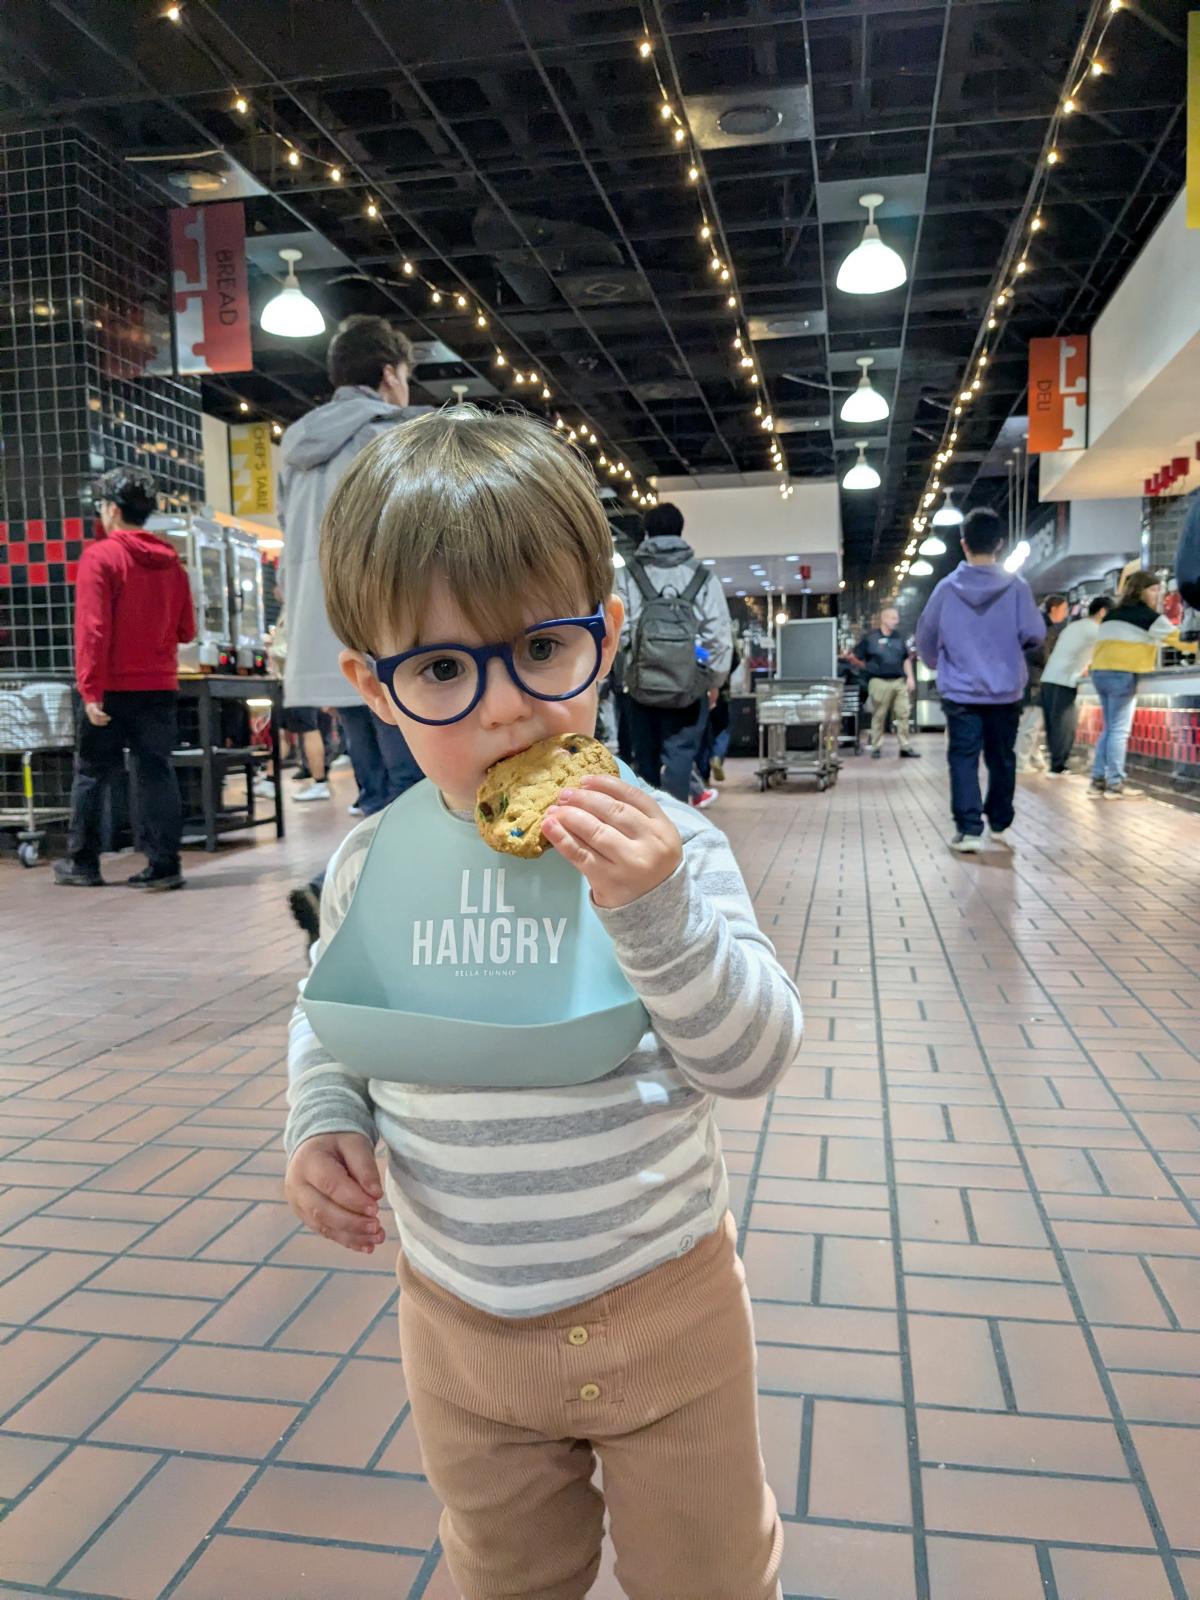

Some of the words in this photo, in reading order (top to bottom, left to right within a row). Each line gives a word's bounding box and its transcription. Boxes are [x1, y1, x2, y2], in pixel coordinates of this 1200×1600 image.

[216, 250, 238, 326] BREAD
[1036, 380, 1052, 411] DELI
[254, 427, 267, 471] CHEF'S
[256, 476, 268, 511] TABLE
[460, 868, 515, 914] LIL
[412, 917, 568, 966] HANGRY
